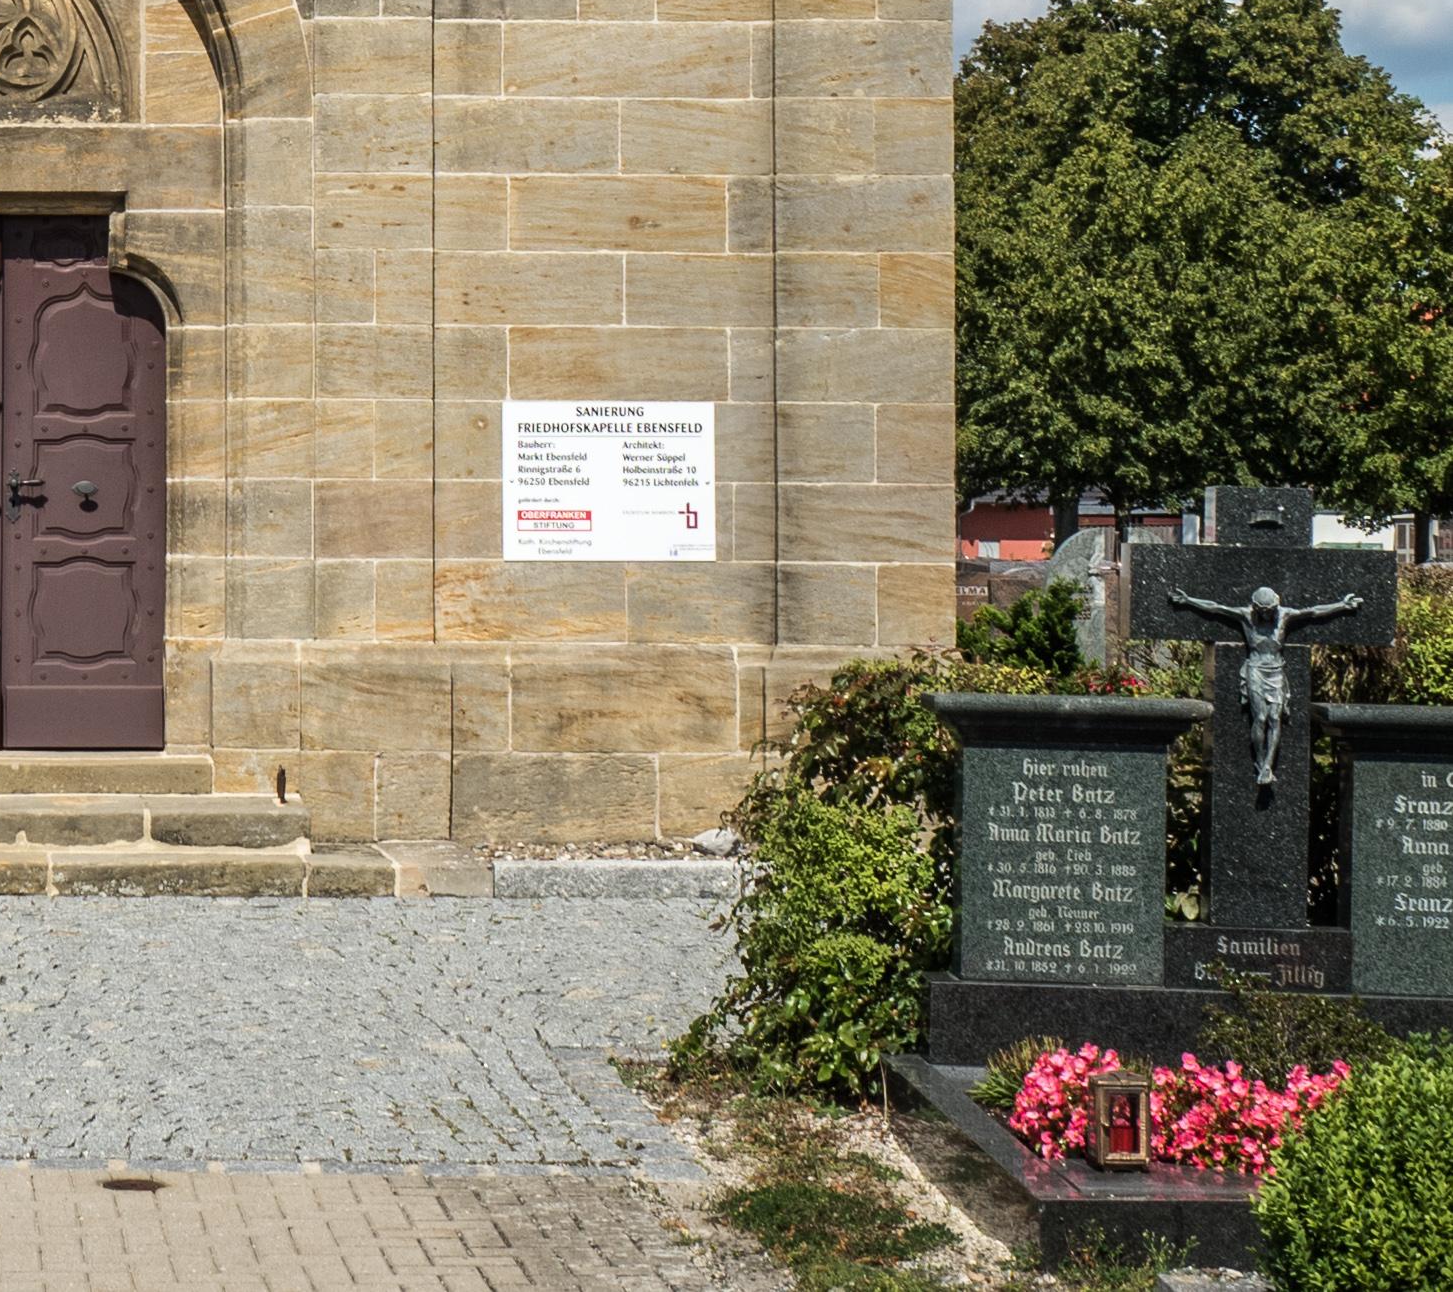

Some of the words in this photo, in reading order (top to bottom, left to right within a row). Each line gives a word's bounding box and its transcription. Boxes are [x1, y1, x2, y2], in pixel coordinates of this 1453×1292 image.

[576, 406, 644, 417] SANIERUNG
[518, 423, 632, 433] FRIEDHOFSKAPELLE
[637, 423, 703, 433] EBENSFELD
[517, 440, 555, 449] Bauherr:
[622, 441, 665, 449] Architekt:
[518, 453, 543, 461] Markt
[546, 452, 588, 461] Ebensfeld
[622, 453, 654, 462] Werner
[575, 465, 581, 473] 6
[622, 465, 683, 474] Holbeinstraße
[686, 466, 697, 474] 10
[517, 477, 545, 486] 96250
[548, 477, 590, 486] Ebensfeld
[622, 478, 650, 487] 96215
[653, 478, 699, 487] Lichtenfels
[520, 511, 587, 519] OBERFRANKEN
[533, 521, 575, 529] STIFTUNG
[1062, 760, 1108, 778] ruhen
[1421, 770, 1437, 788] in
[1012, 781, 1064, 804] Peter
[1036, 823, 1092, 844] Maria
[1100, 825, 1140, 846] Batz
[1402, 834, 1450, 855] Anna
[992, 879, 1081, 903] Margarete
[1092, 881, 1134, 903] Batz
[1394, 892, 1453, 913] Franz
[1004, 935, 1071, 958] Andreas
[1080, 939, 1124, 960] Batz
[1217, 935, 1301, 957] Familien
